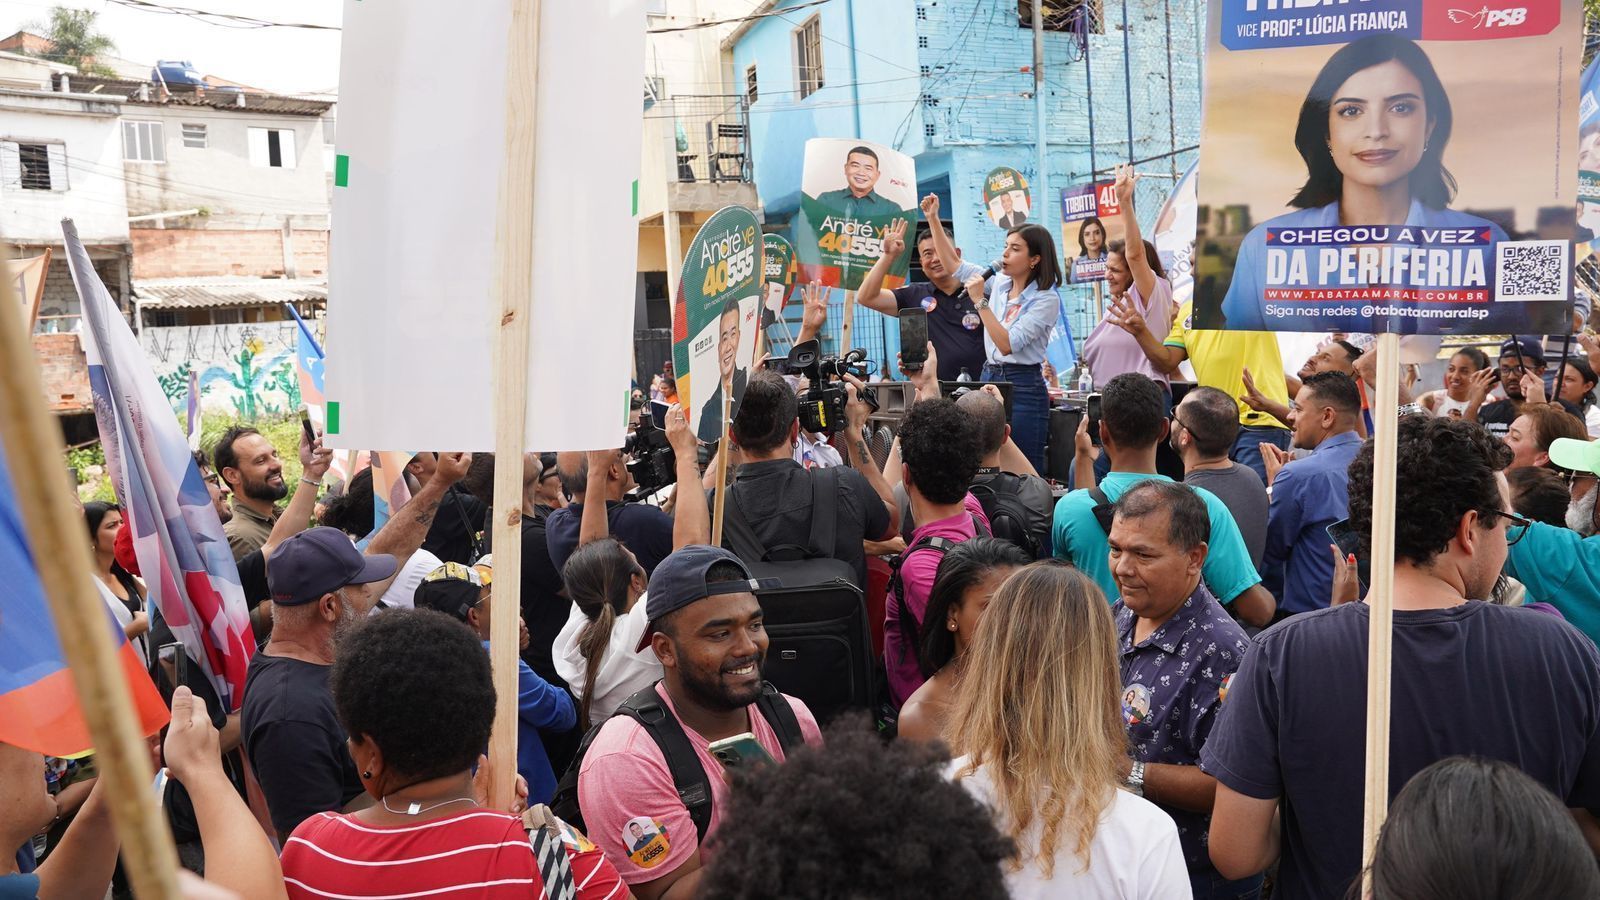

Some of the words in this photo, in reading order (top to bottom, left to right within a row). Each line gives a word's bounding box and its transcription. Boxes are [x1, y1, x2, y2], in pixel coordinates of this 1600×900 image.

[1237, 23, 1258, 37] VICE
[1305, 14, 1347, 35] LÚCIA
[1350, 10, 1408, 32] FRANÇA
[1485, 7, 1528, 28] PSB
[1064, 193, 1097, 215] TABATA
[1099, 185, 1119, 208] 40
[819, 215, 874, 237] André
[1279, 228, 1389, 244] CHEGOU
[1397, 228, 1415, 242] A
[1421, 229, 1476, 243] VEZ
[700, 224, 741, 269] André
[702, 244, 754, 297] 40555
[1266, 248, 1309, 286] DA
[1318, 247, 1487, 287] PERIFERIA
[1267, 290, 1484, 301] WWW.TABATAAMARAL.COM.BR
[1265, 304, 1294, 318] Siga
[1296, 307, 1320, 317] nas
[1322, 305, 1358, 317] redes
[1360, 305, 1490, 320] @tabataamaralsp
[643, 844, 665, 862] 40555
